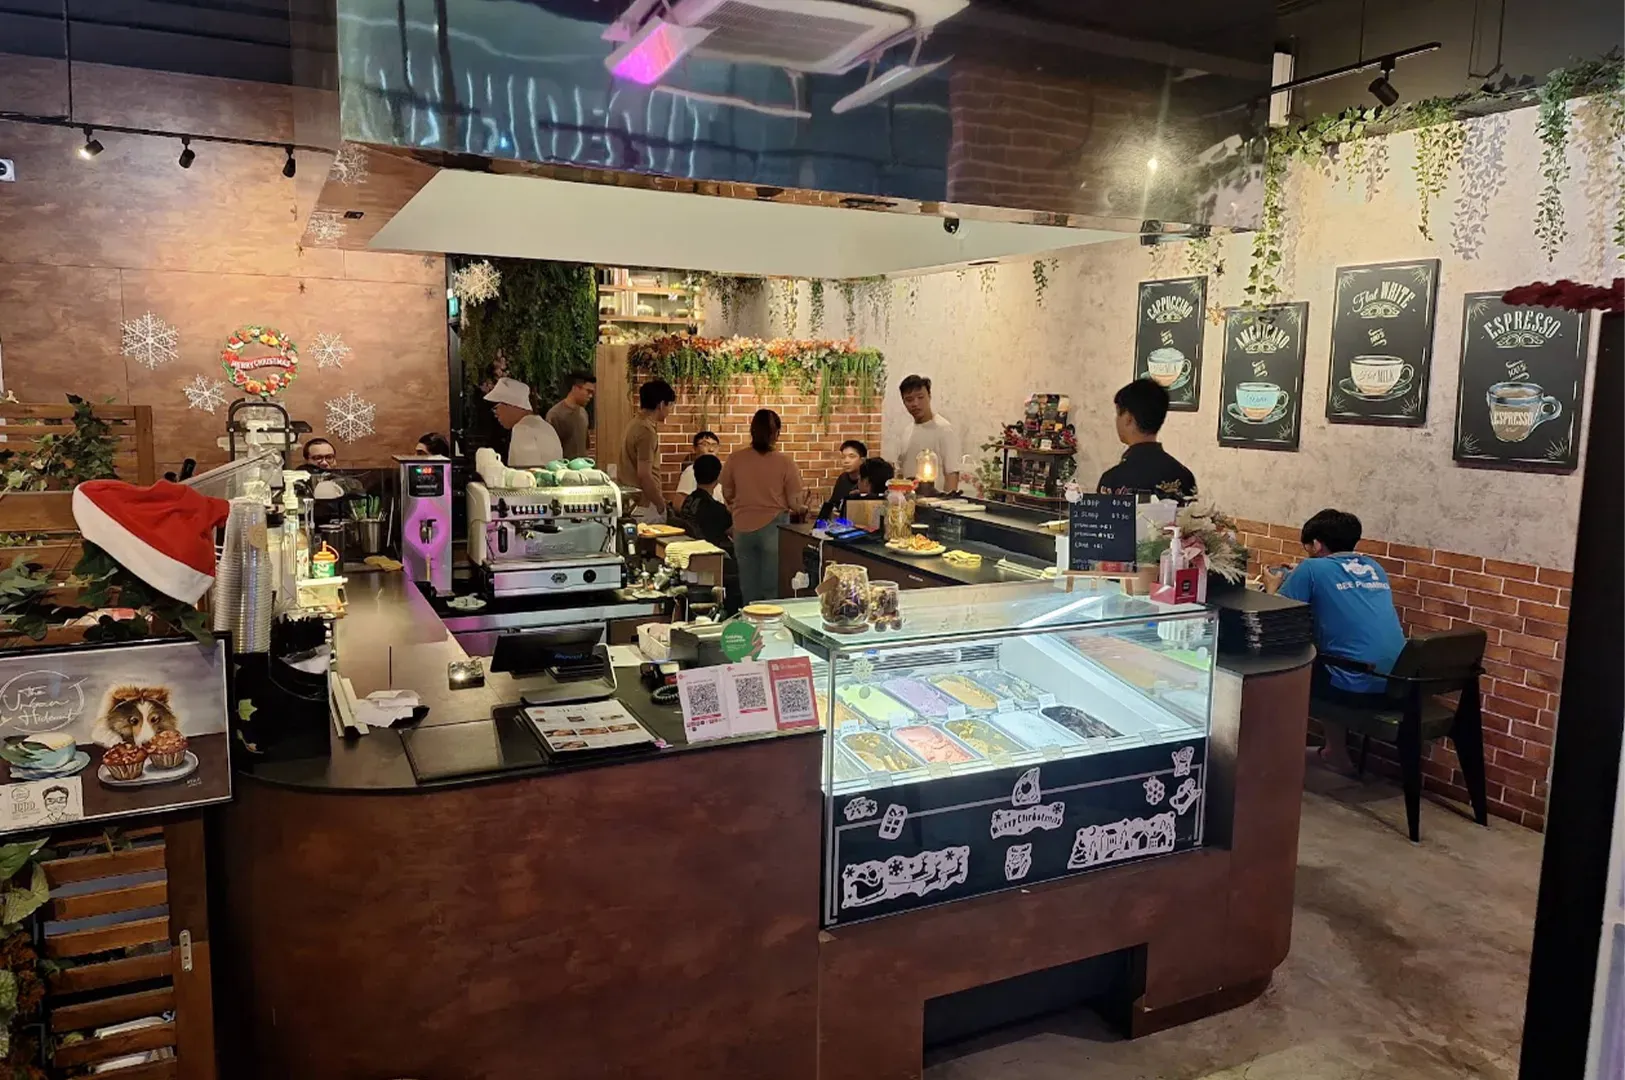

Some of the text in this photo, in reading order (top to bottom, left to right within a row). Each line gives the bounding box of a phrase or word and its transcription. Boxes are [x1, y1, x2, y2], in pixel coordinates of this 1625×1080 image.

[1146, 295, 1193, 320] CAPPUCCINO
[1352, 281, 1416, 313] Flat WHITE
[1235, 321, 1290, 350] AMERICANO
[1483, 310, 1561, 341] ESPRESSO
[1492, 410, 1534, 426] ESPRESSO
[1017, 811, 1062, 826] Christmas
